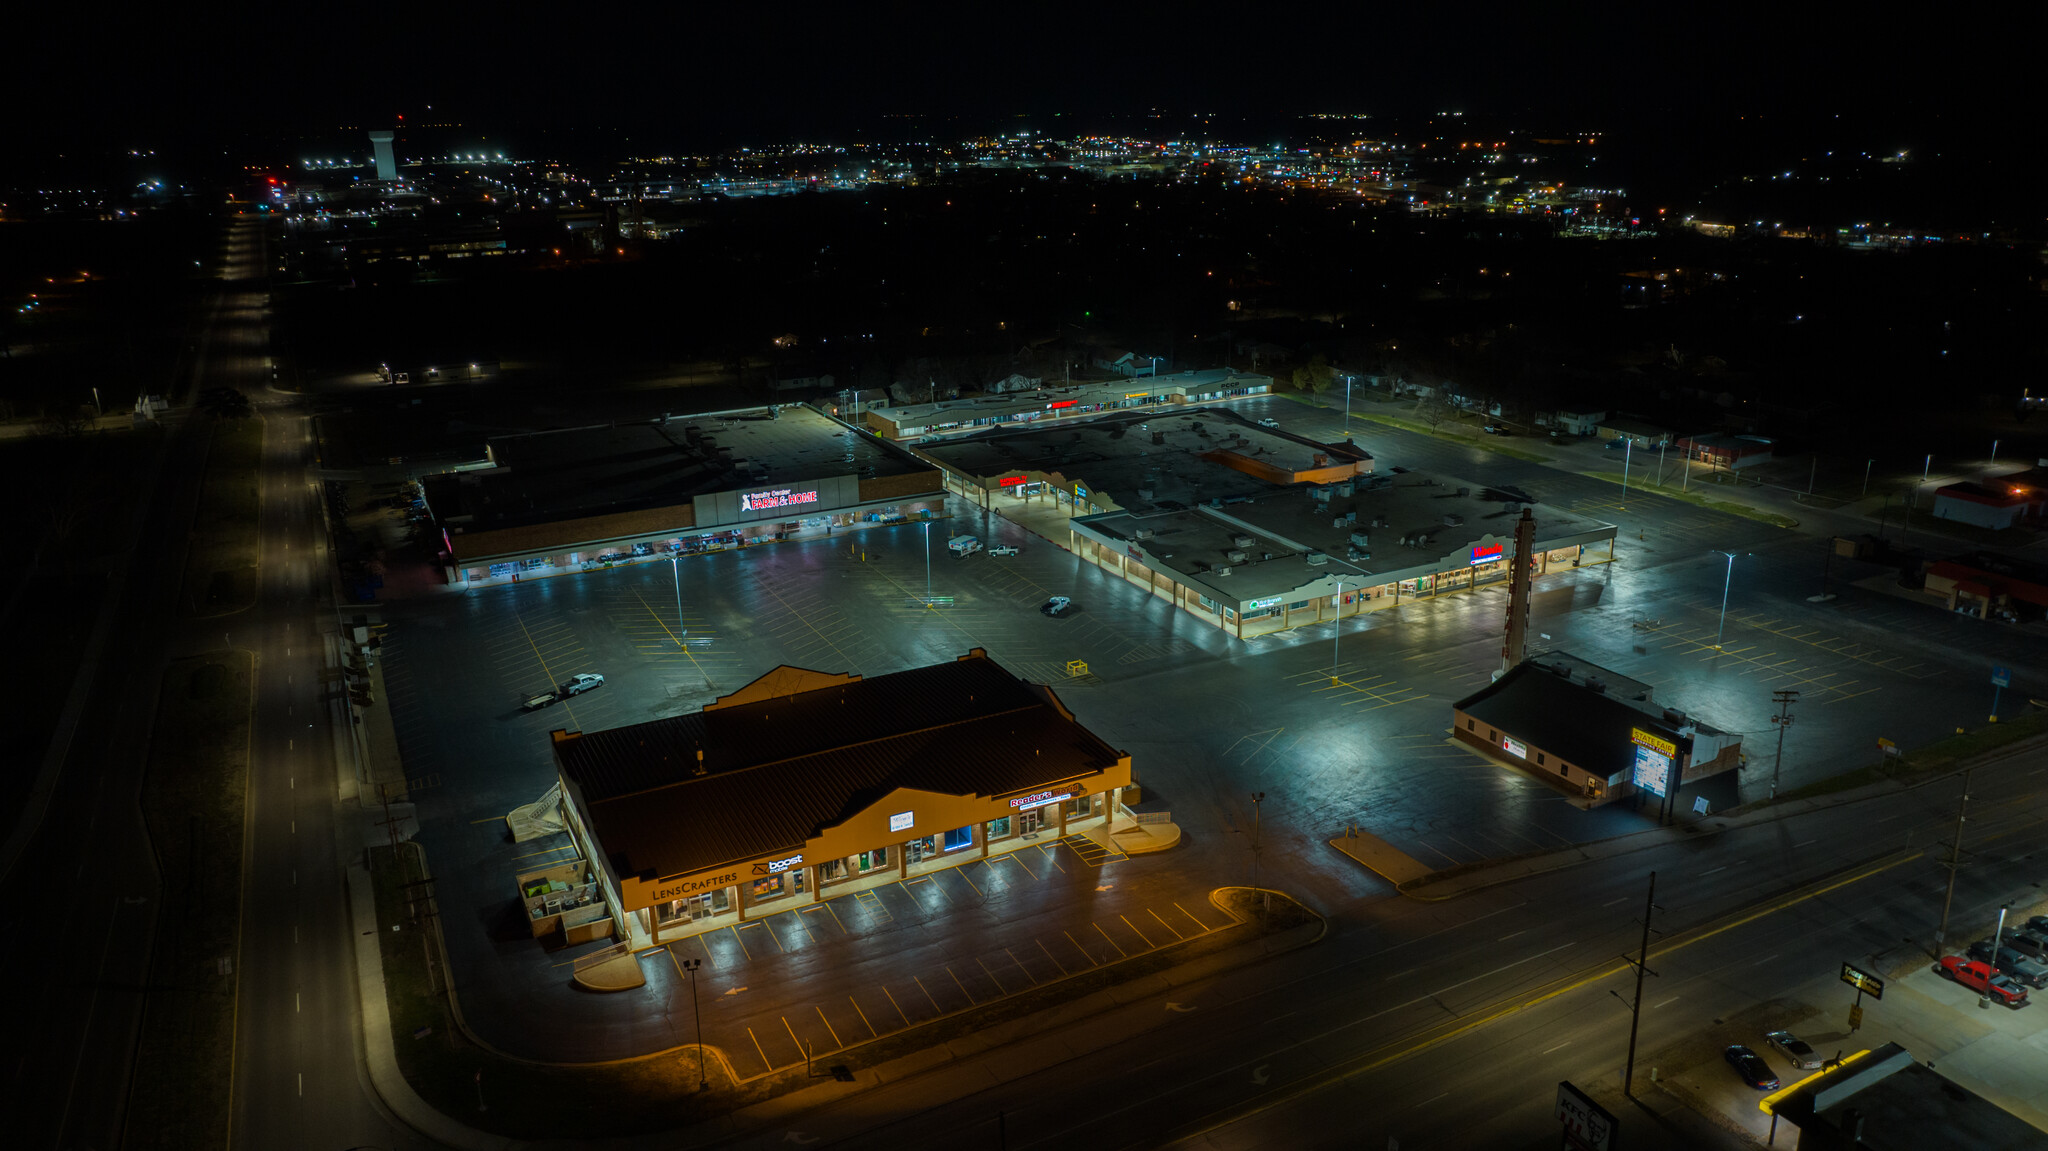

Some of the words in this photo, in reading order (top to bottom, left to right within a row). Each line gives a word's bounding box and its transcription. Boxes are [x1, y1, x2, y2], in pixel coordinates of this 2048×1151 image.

[751, 497, 778, 510] FARM
[779, 496, 788, 506] &
[788, 491, 817, 505] HOME
[1473, 543, 1503, 558] Woods
[1634, 731, 1656, 747] STATE
[1656, 740, 1673, 752] FAIR
[1634, 737, 1655, 750] SHOPPING
[1656, 747, 1672, 757] CENTER
[1010, 791, 1052, 807] Reader's
[1052, 784, 1079, 797] World
[769, 854, 803, 869] boost
[769, 866, 788, 874] mobile
[1561, 1099, 1586, 1121] KFC
